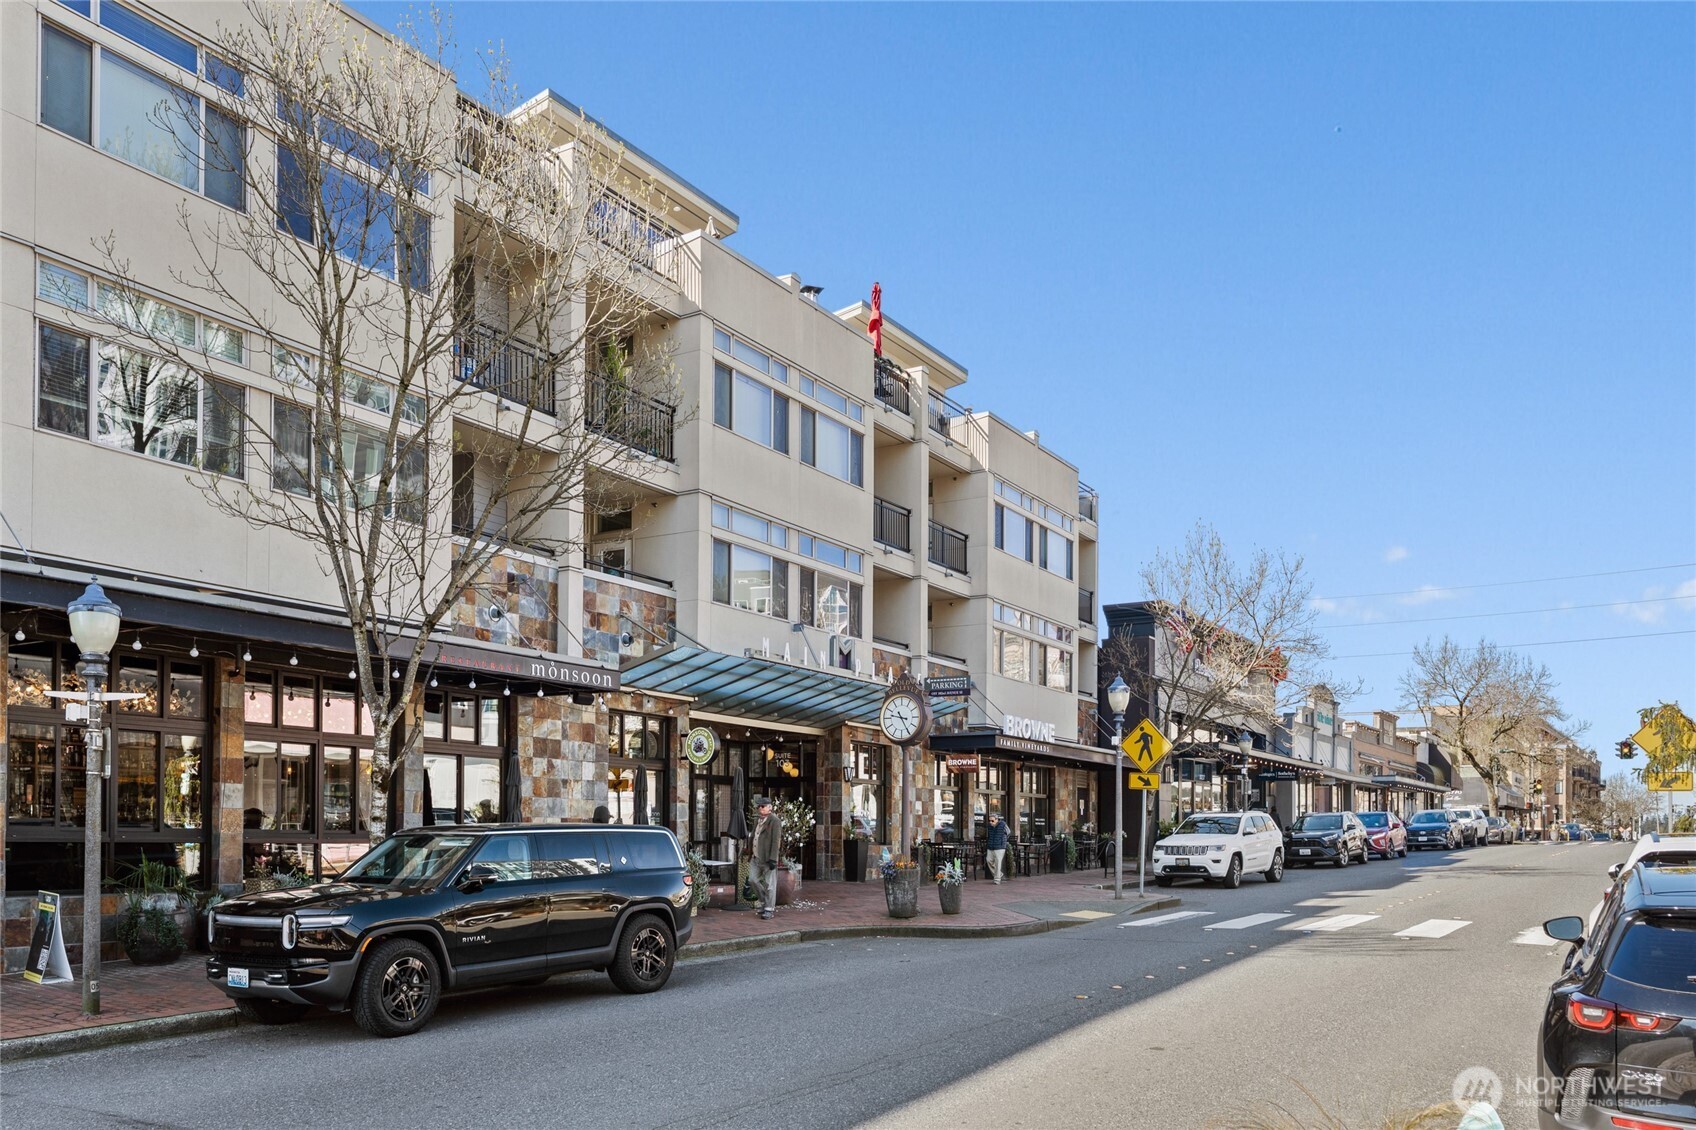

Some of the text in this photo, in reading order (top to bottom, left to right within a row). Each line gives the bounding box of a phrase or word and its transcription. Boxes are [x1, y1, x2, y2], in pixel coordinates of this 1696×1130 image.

[762, 637, 826, 669] MAIN
[441, 655, 521, 673] RESTAURANT
[888, 684, 919, 696] BELLEVUE
[931, 681, 963, 690] PARKING
[1003, 715, 1056, 743] BROWNE
[1000, 738, 1050, 753] FAMILY VINEYARDS
[948, 758, 977, 766] BROWNE
[462, 935, 486, 943] RIVIAN
